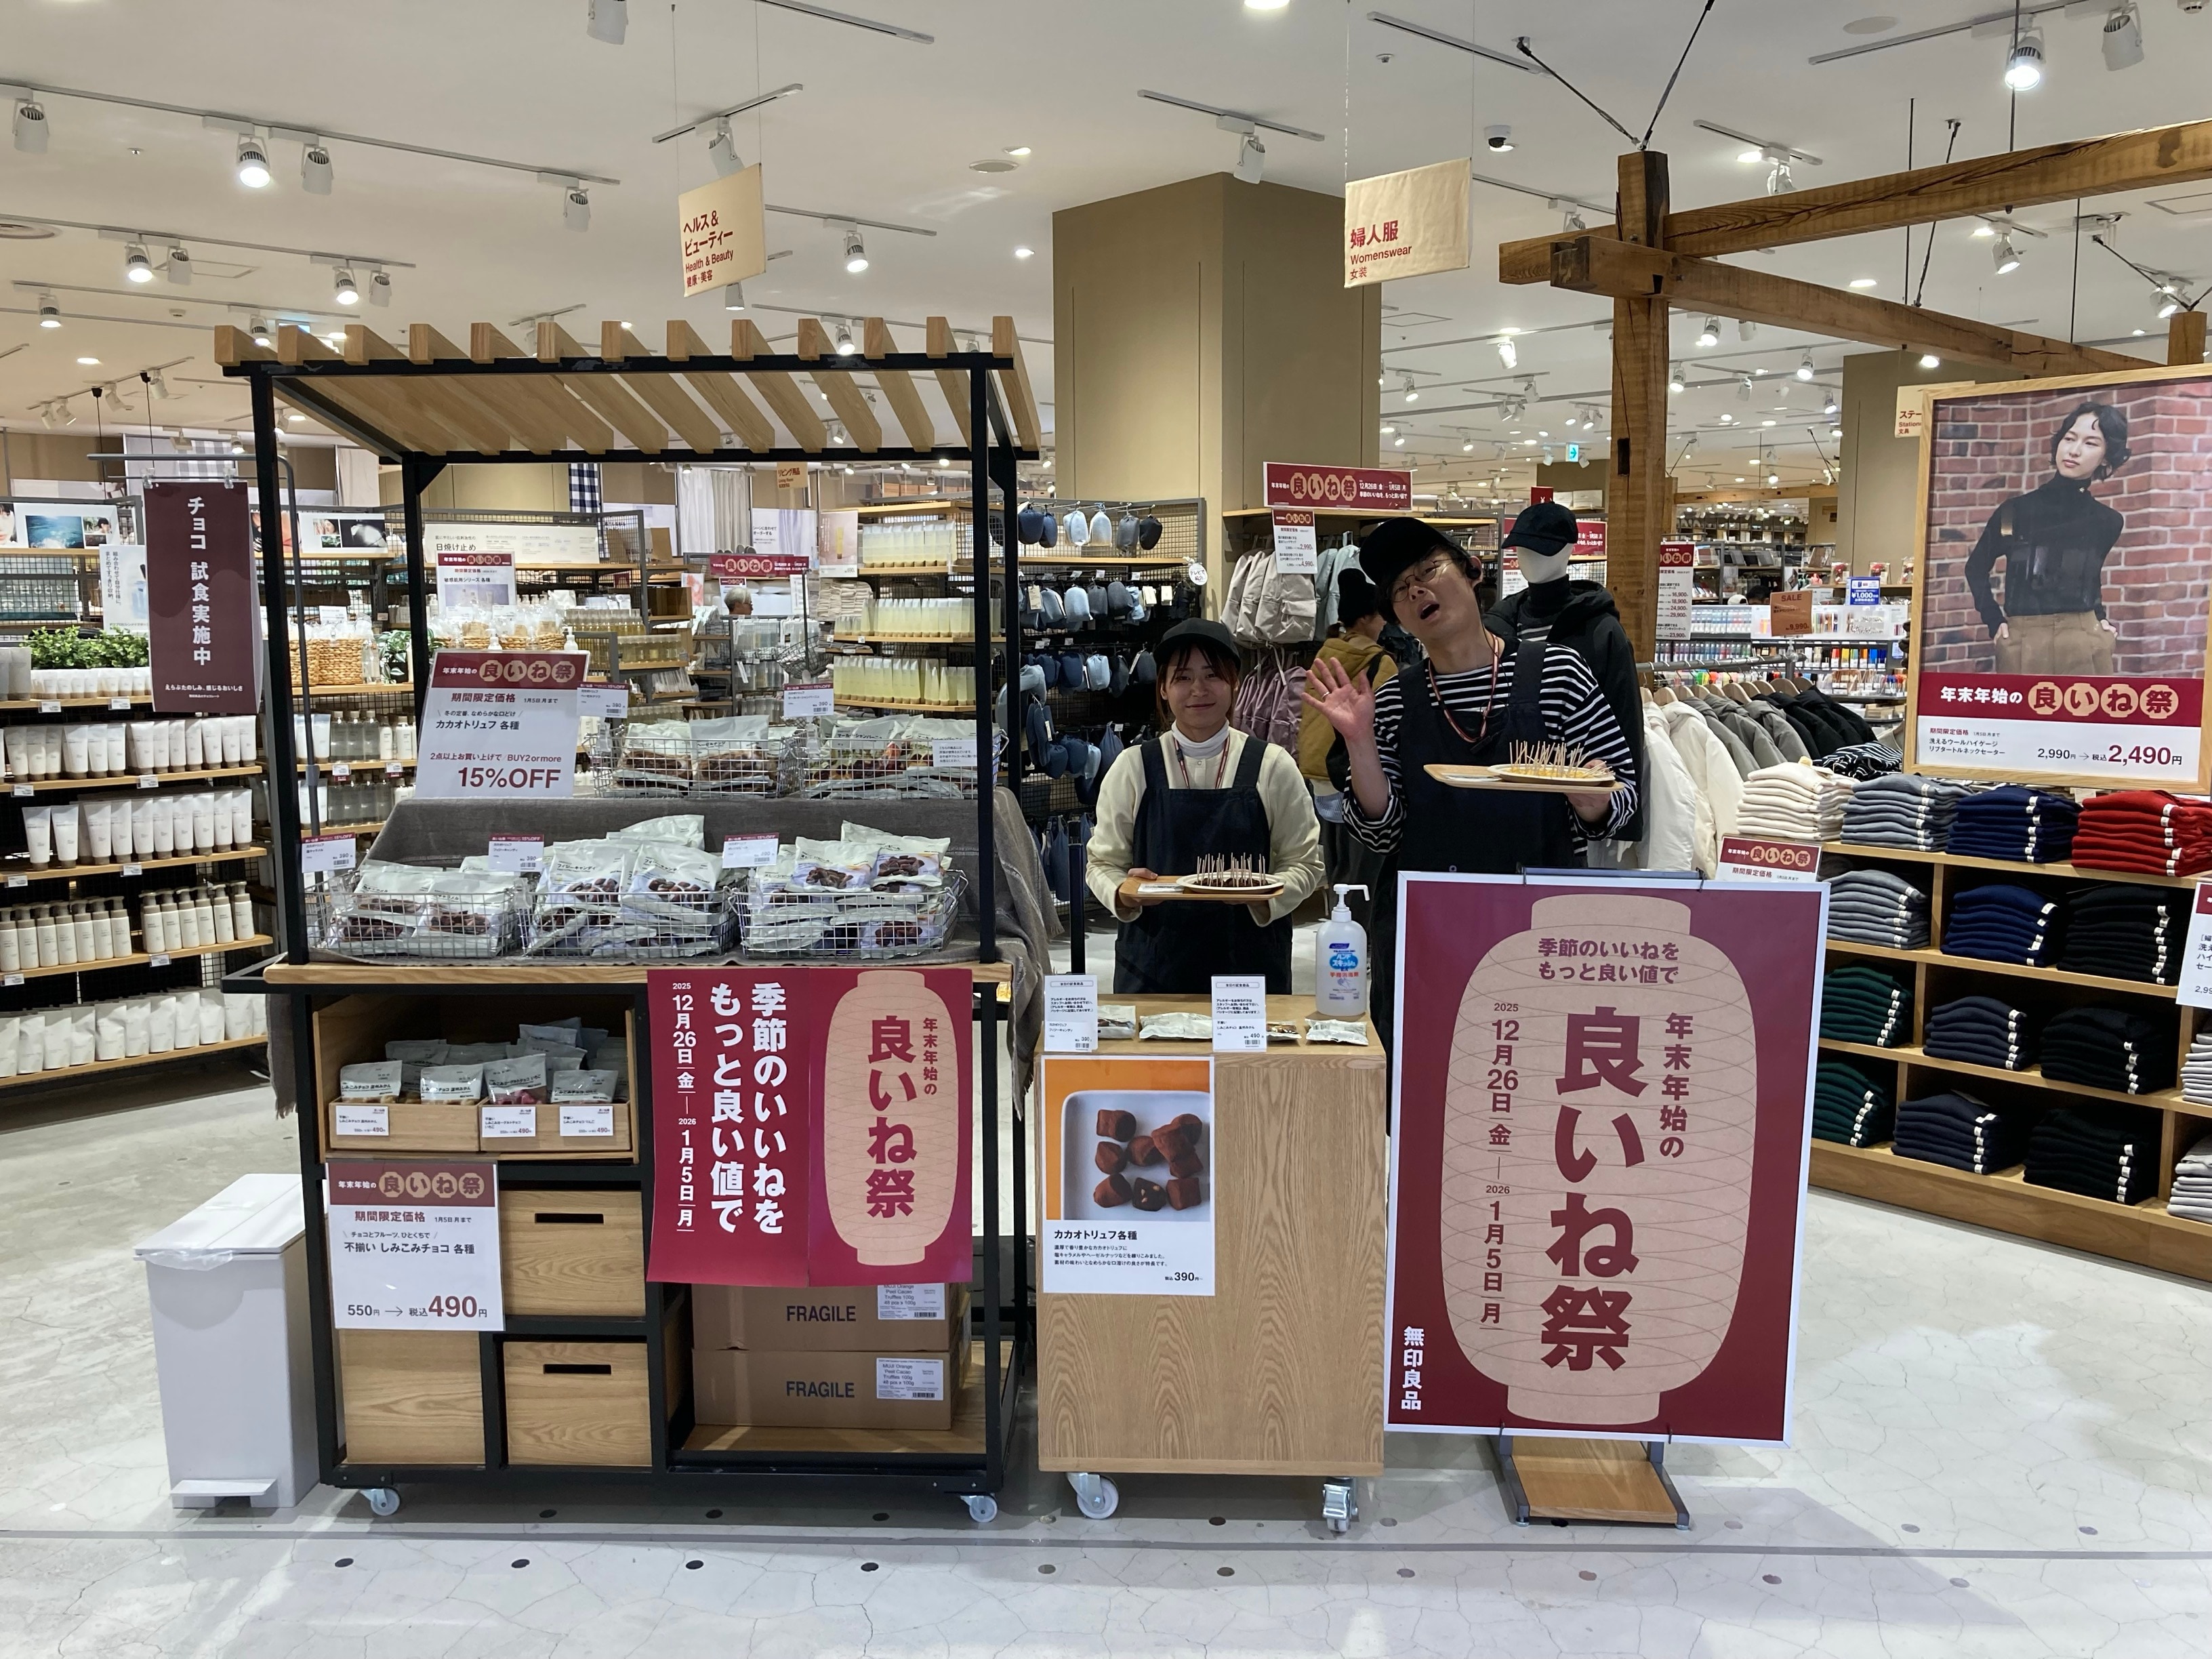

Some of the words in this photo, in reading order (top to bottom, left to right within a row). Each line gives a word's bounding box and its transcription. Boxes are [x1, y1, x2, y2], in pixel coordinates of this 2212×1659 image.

[683, 213, 710, 234] ヘルス
[711, 210, 719, 227] &
[1350, 220, 1399, 249] 婦人服
[684, 230, 733, 258] ビューティー
[685, 258, 703, 273] Health
[705, 255, 710, 266] &
[711, 249, 734, 264] Beauty
[1350, 245, 1412, 265] Womenswear
[687, 269, 713, 288] 健康・美容
[1350, 266, 1368, 281] 女装
[1899, 410, 1922, 419] ステー
[1292, 476, 1355, 497] 良いね祭
[187, 496, 206, 550] チョコ
[436, 543, 476, 552] 日焼け止め
[726, 560, 772, 572] 良いね祭
[1781, 594, 1803, 602] SALE
[190, 561, 211, 665] 試食実施中
[442, 666, 478, 675] 年末年始の
[482, 662, 573, 680] 良いね祭
[165, 683, 243, 692] えらぶたのしみ、感じるおいしさ
[451, 692, 516, 703] 期間限定価格
[1940, 686, 2023, 705] 年末年始の
[2032, 687, 2173, 714] 良いね祭
[436, 720, 497, 730] カカオトリュフ
[499, 720, 520, 731] 各種
[1929, 727, 1969, 736] 期間限定価格
[1929, 737, 1999, 747] 洗えるウールハイゲージ
[430, 752, 502, 761] 2点以上お買い上げで
[1929, 746, 2005, 756] リブタートルネックセーター
[2037, 747, 2076, 760] 2,990円
[457, 766, 561, 789] 15%OFF
[1752, 848, 1809, 865] 良いね祭
[1732, 867, 1772, 878] 期間限定価格
[1538, 938, 1679, 962] 季節のいいねを
[1538, 961, 1679, 985] もっと良い値で
[1494, 1002, 1519, 1012] 2025
[922, 1017, 938, 1095] 年末年始の
[1659, 1012, 1694, 1159] 年末年始の
[710, 983, 745, 1233] もっと良い値で
[751, 982, 787, 1234] 季節のいいねを
[865, 1015, 918, 1218] 良いね祭
[678, 1118, 697, 1126] 2026
[338, 1180, 377, 1189] 年末年始の
[382, 1174, 480, 1195] 良いね祭
[1486, 1185, 1511, 1195] 2026
[1540, 1006, 1649, 1372] 良いね祭
[354, 1210, 426, 1223] 期間限定価格
[350, 1231, 430, 1240] チョコとフルーツ、ひとくちで
[1054, 1229, 1138, 1241] カカオトリュフ各種
[344, 1242, 376, 1253] 不揃い
[380, 1243, 450, 1254] しみこみチョコ
[453, 1244, 475, 1255] 各種
[347, 1305, 380, 1317] 550円
[786, 1305, 857, 1322] FRAGILE
[1400, 1326, 1425, 1411] 無印良品
[786, 1380, 855, 1398] FRAGILE
